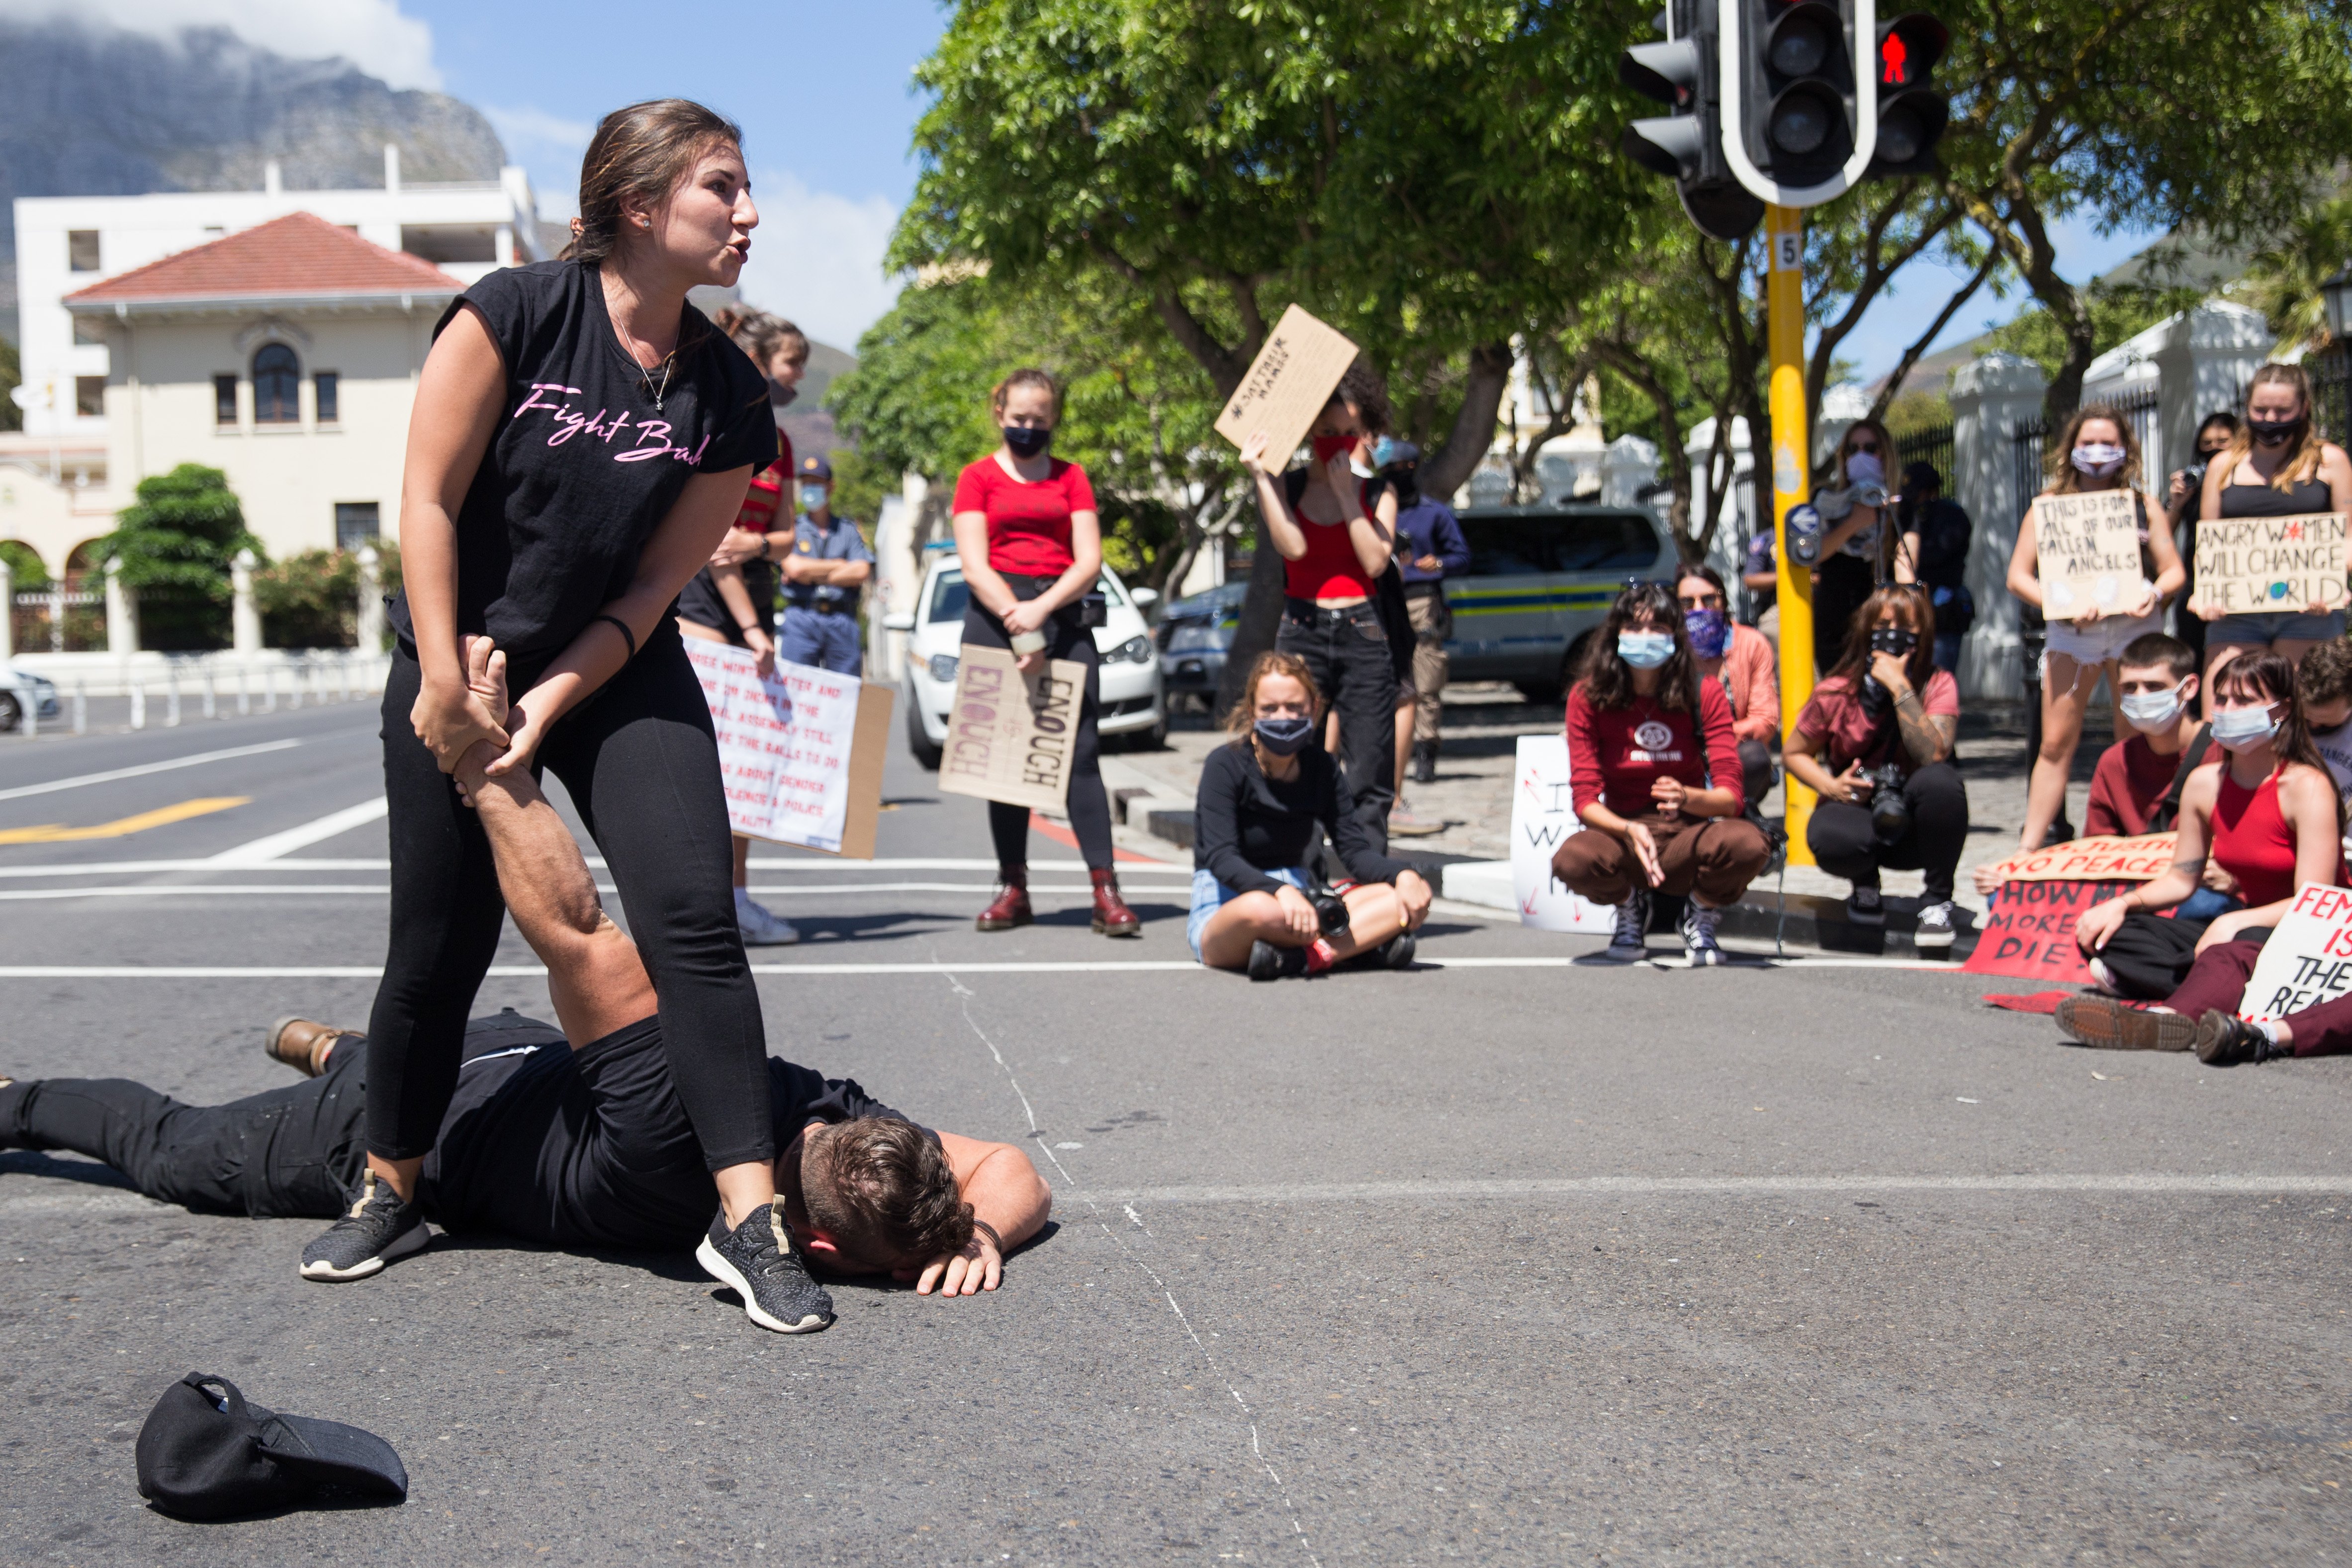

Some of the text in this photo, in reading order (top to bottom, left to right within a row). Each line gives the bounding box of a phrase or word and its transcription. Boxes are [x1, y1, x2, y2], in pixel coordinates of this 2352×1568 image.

[1783, 238, 1794, 265] 5
[1257, 337, 1288, 378] THEIR
[514, 383, 630, 447] Fight
[2039, 496, 2129, 521] THIS IS FOR
[2042, 515, 2133, 538] ALL OF OUR
[2196, 522, 2260, 550] ANGRY
[2038, 536, 2098, 556] FALLEN
[2068, 553, 2137, 574] ANGELS
[2196, 546, 2344, 578] WILL CHANGE
[2197, 581, 2239, 612] THE
[772, 672, 812, 691] LATER
[818, 684, 841, 699] AND
[798, 703, 819, 718] THE
[738, 713, 798, 737] ASSEMBLY
[805, 727, 832, 745] STILL
[739, 735, 759, 751] THE
[765, 741, 801, 761] BALLS
[807, 750, 820, 765] TO
[824, 755, 839, 769] DO
[737, 766, 774, 782] ABOUT
[779, 775, 824, 794] GENDER
[784, 799, 824, 818] POLICE
[1545, 783, 1570, 813] I
[1996, 855, 2173, 874] NO PEACE
[2001, 880, 2084, 907] HOW
[1988, 912, 2076, 935] MORE
[2293, 955, 2352, 992] THE
